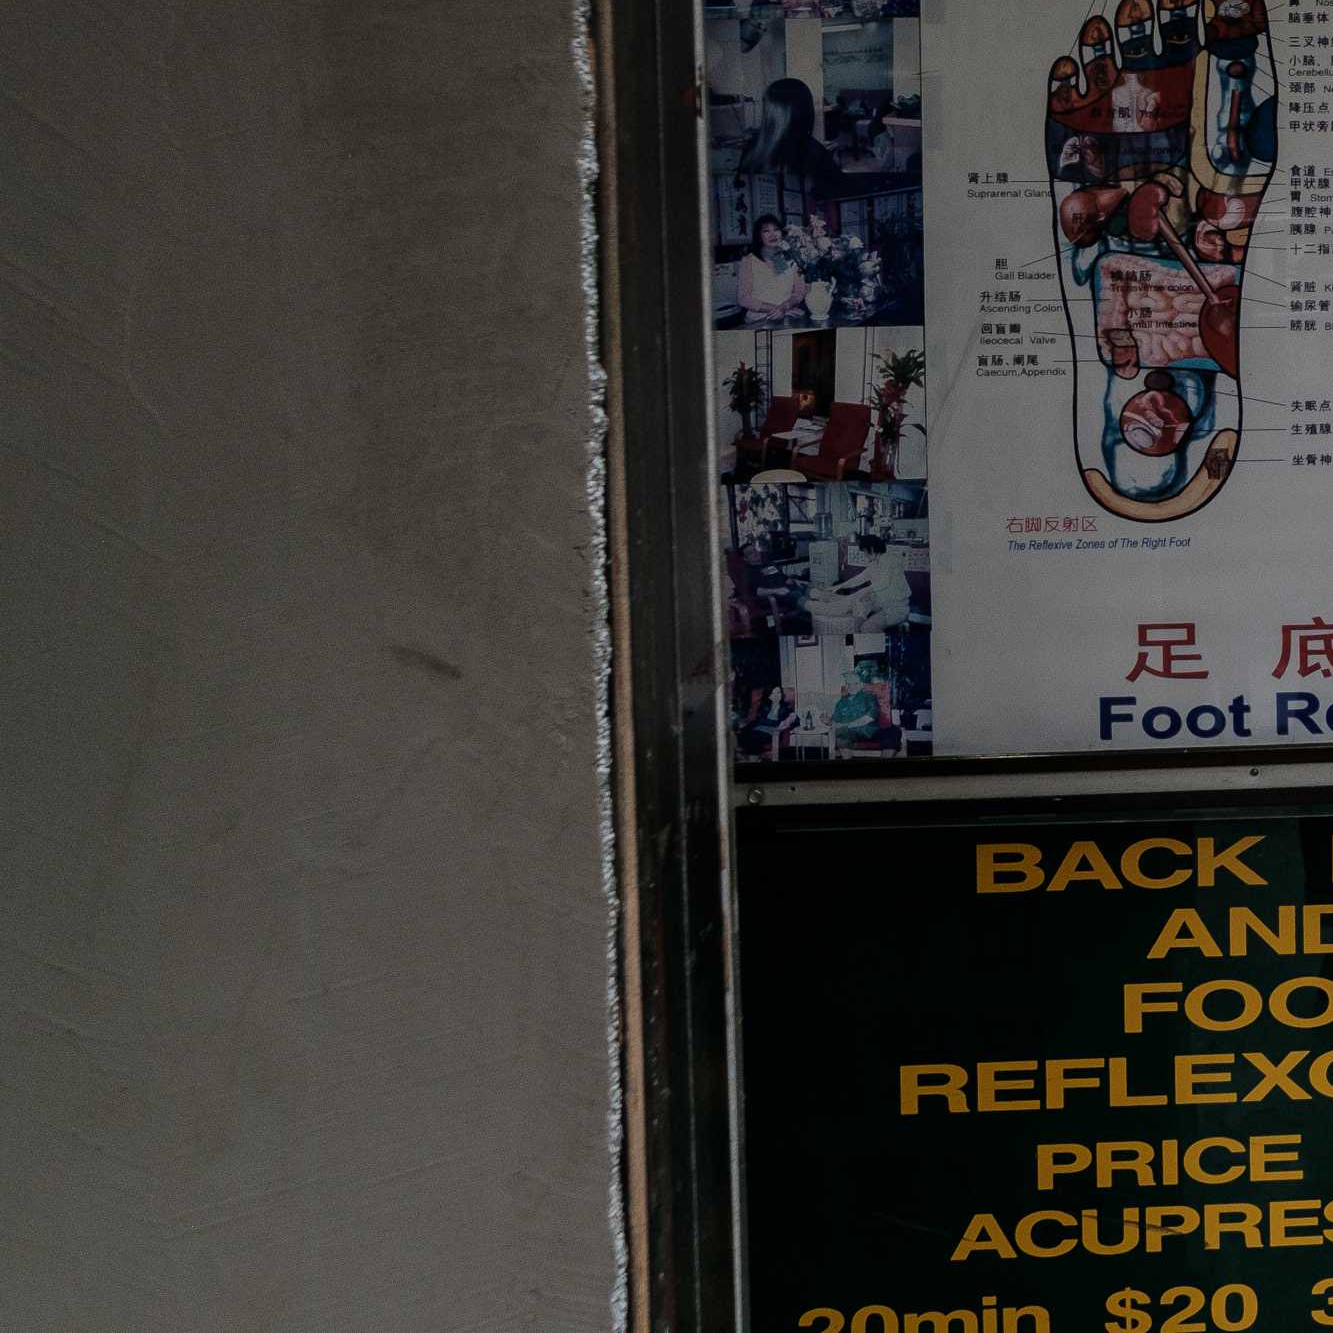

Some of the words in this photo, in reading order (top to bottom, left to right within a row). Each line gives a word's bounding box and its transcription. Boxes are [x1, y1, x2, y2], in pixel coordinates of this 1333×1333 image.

[967, 189, 1023, 200] Suprarenal
[995, 272, 1018, 281] Gall
[1020, 272, 1055, 281] Bladder
[980, 304, 1031, 315] Ascending
[1034, 304, 1063, 313] Colon
[1030, 336, 1056, 345] Valve
[1007, 540, 1026, 551] The
[1029, 539, 1073, 550] Reflexive
[1076, 539, 1105, 549] Zones
[1108, 538, 1118, 548] of
[1121, 538, 1138, 548] The
[1141, 537, 1170, 550] Right
[1170, 537, 1191, 547] Foot
[1099, 696, 1249, 740] Foot
[977, 836, 1267, 893] BACK
[1037, 1134, 1303, 1191] PRICE
[1105, 1284, 1258, 1333] $20
